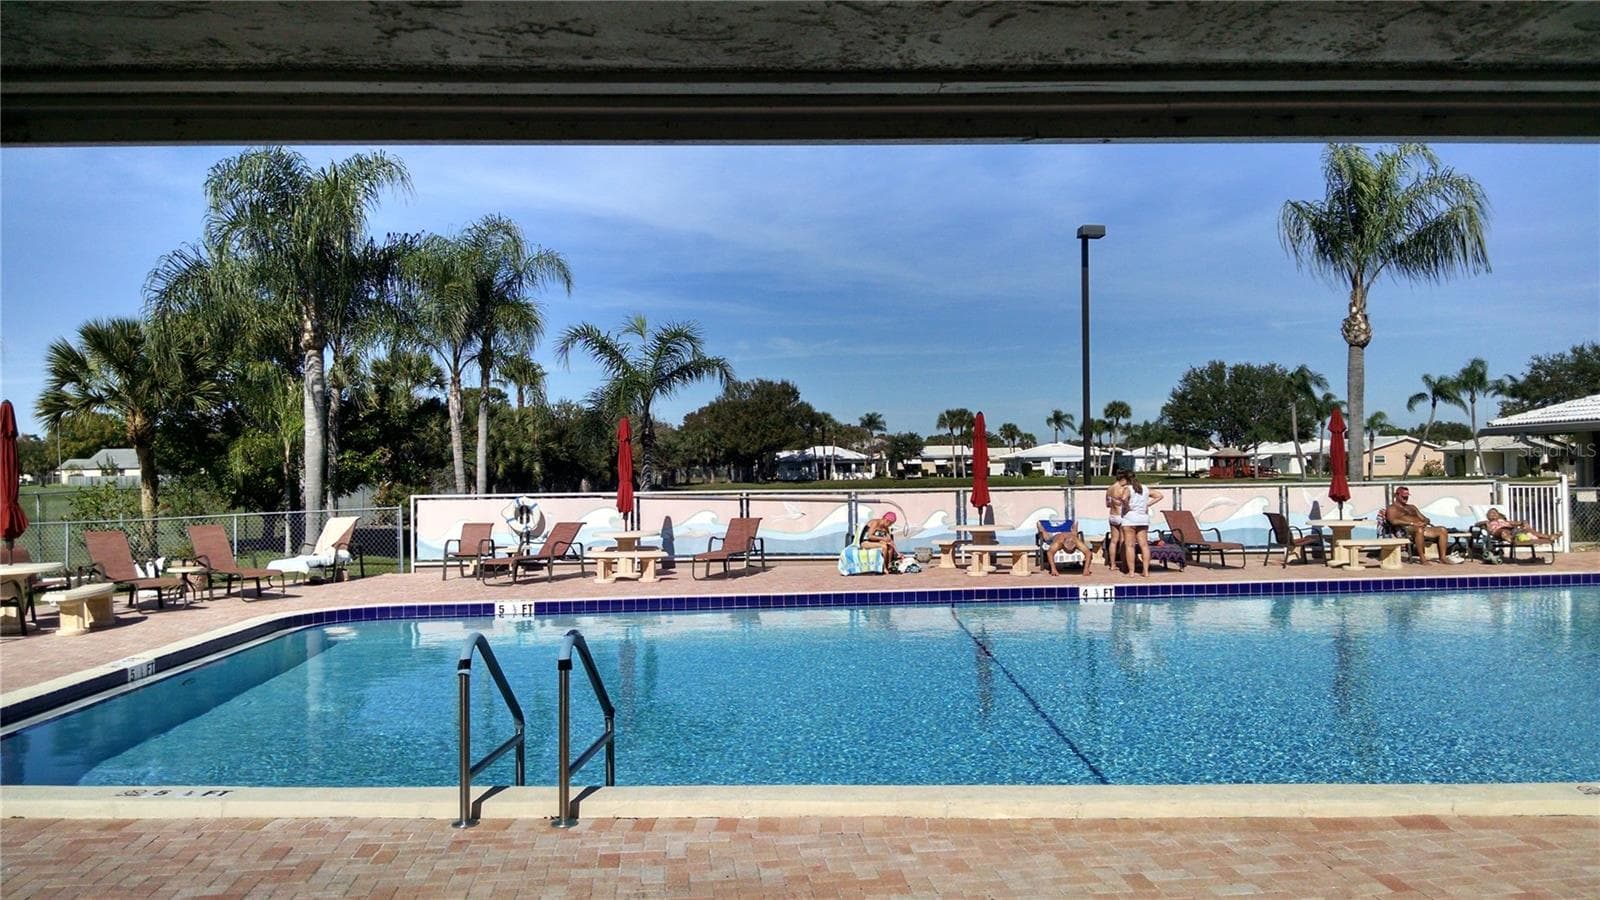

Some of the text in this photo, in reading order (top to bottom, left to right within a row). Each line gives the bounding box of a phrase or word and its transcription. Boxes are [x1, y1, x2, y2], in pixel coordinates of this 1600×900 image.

[1103, 588, 1113, 600] FT
[498, 604, 505, 615] 5
[521, 603, 533, 616] FT
